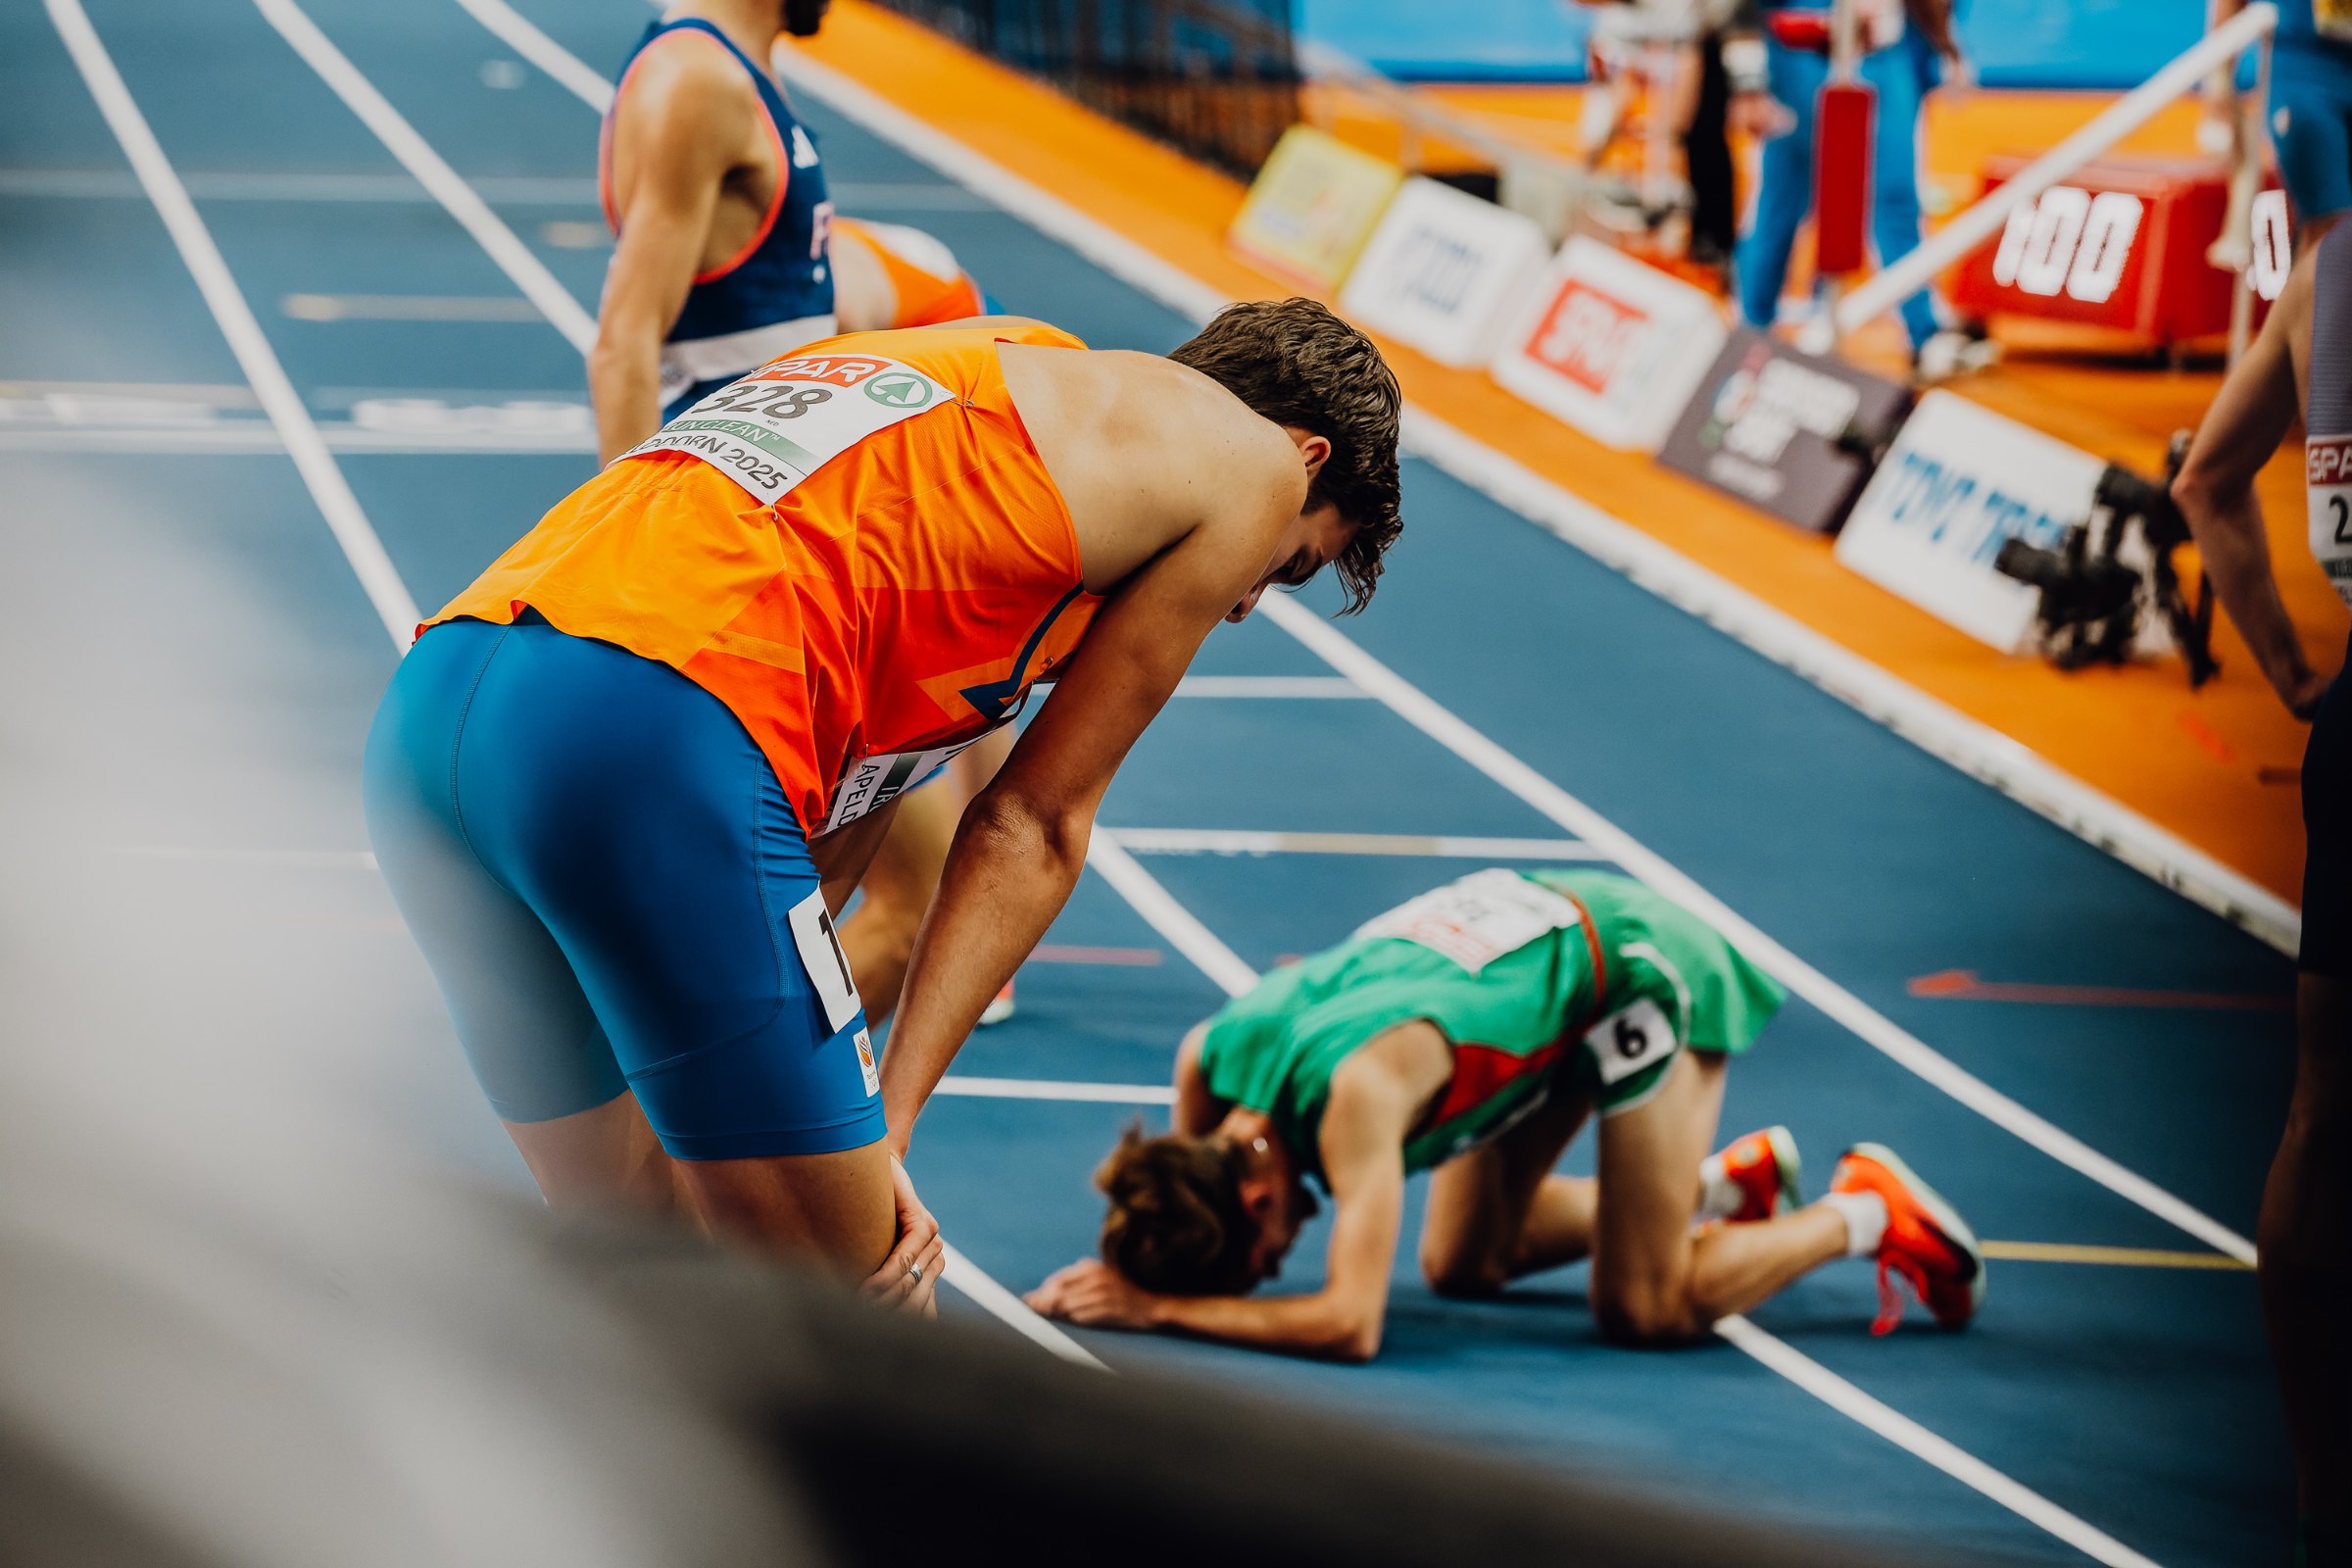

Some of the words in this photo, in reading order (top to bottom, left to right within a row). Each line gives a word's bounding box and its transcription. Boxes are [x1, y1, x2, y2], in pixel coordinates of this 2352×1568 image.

[691, 385, 832, 418] 328
[719, 448, 788, 490] 2025
[818, 908, 854, 997] 1
[1614, 1016, 1647, 1059] 6
